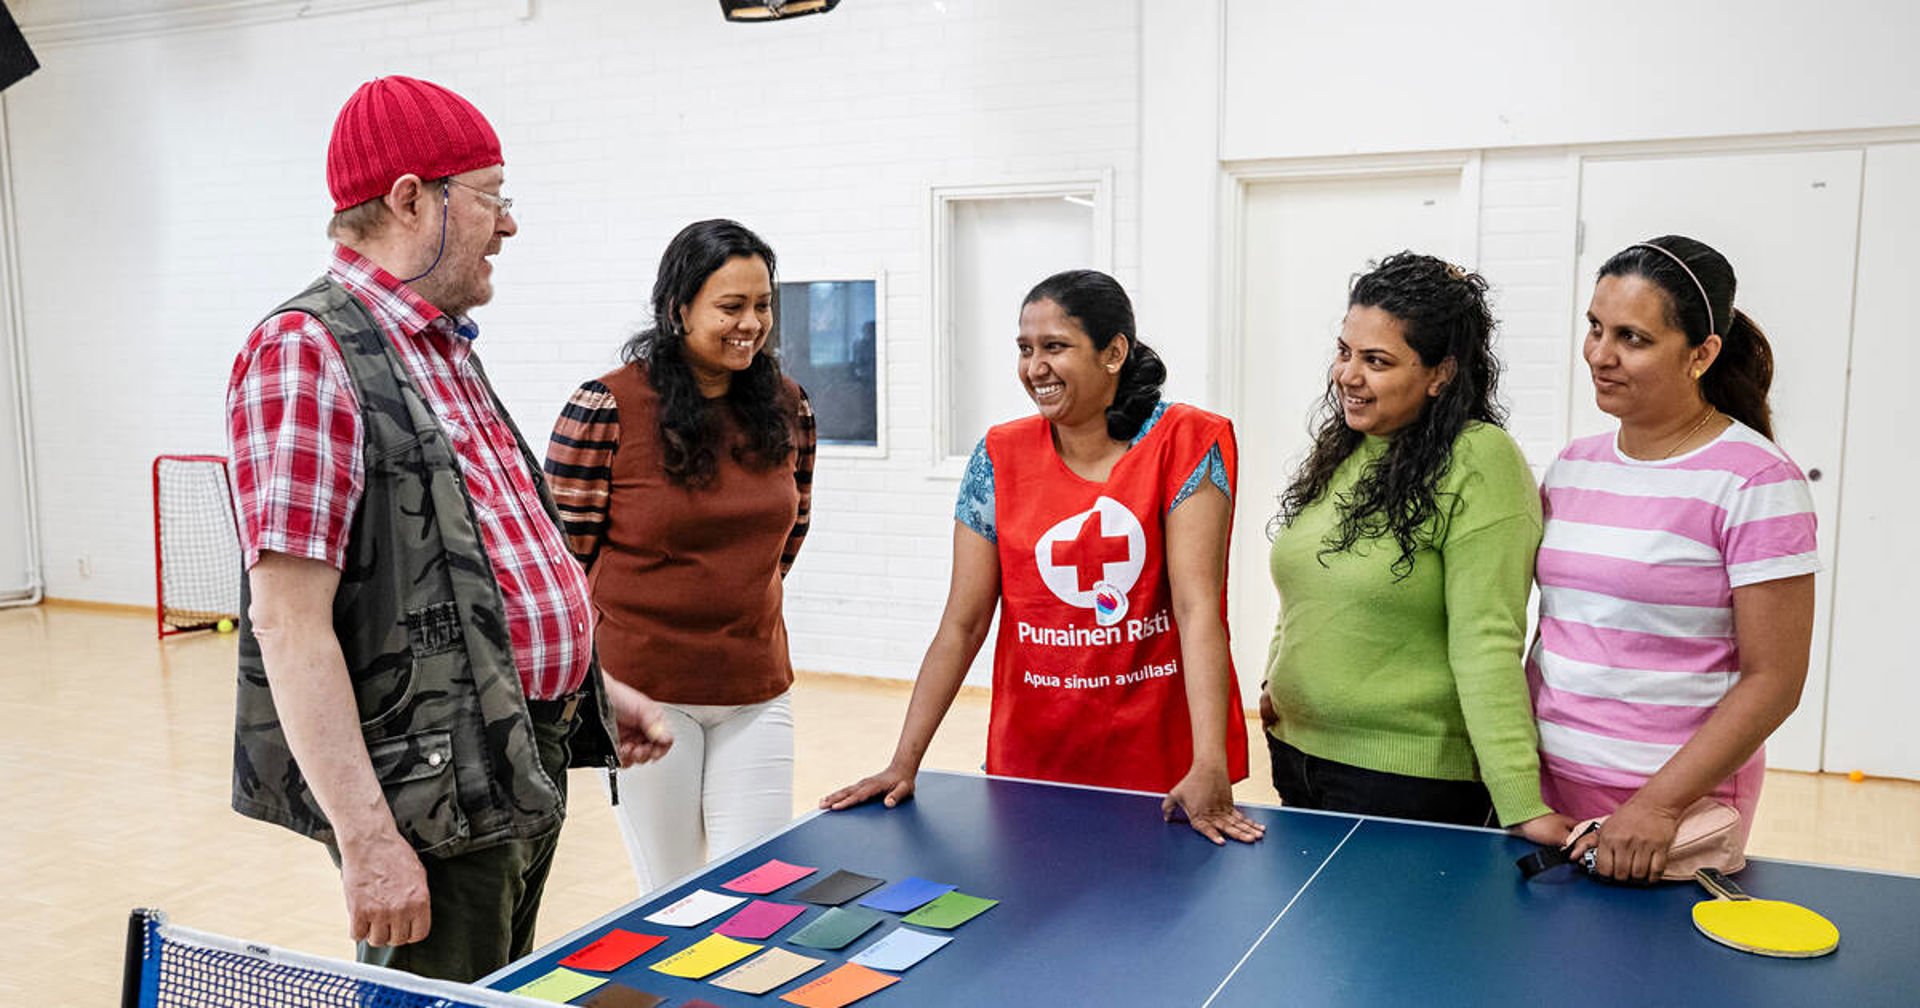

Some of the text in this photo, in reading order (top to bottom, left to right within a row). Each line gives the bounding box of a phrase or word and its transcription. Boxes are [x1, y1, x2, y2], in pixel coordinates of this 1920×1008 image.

[1018, 609, 1170, 647] Punainen Risti
[1023, 659, 1178, 689] Apua sinun avullasi
